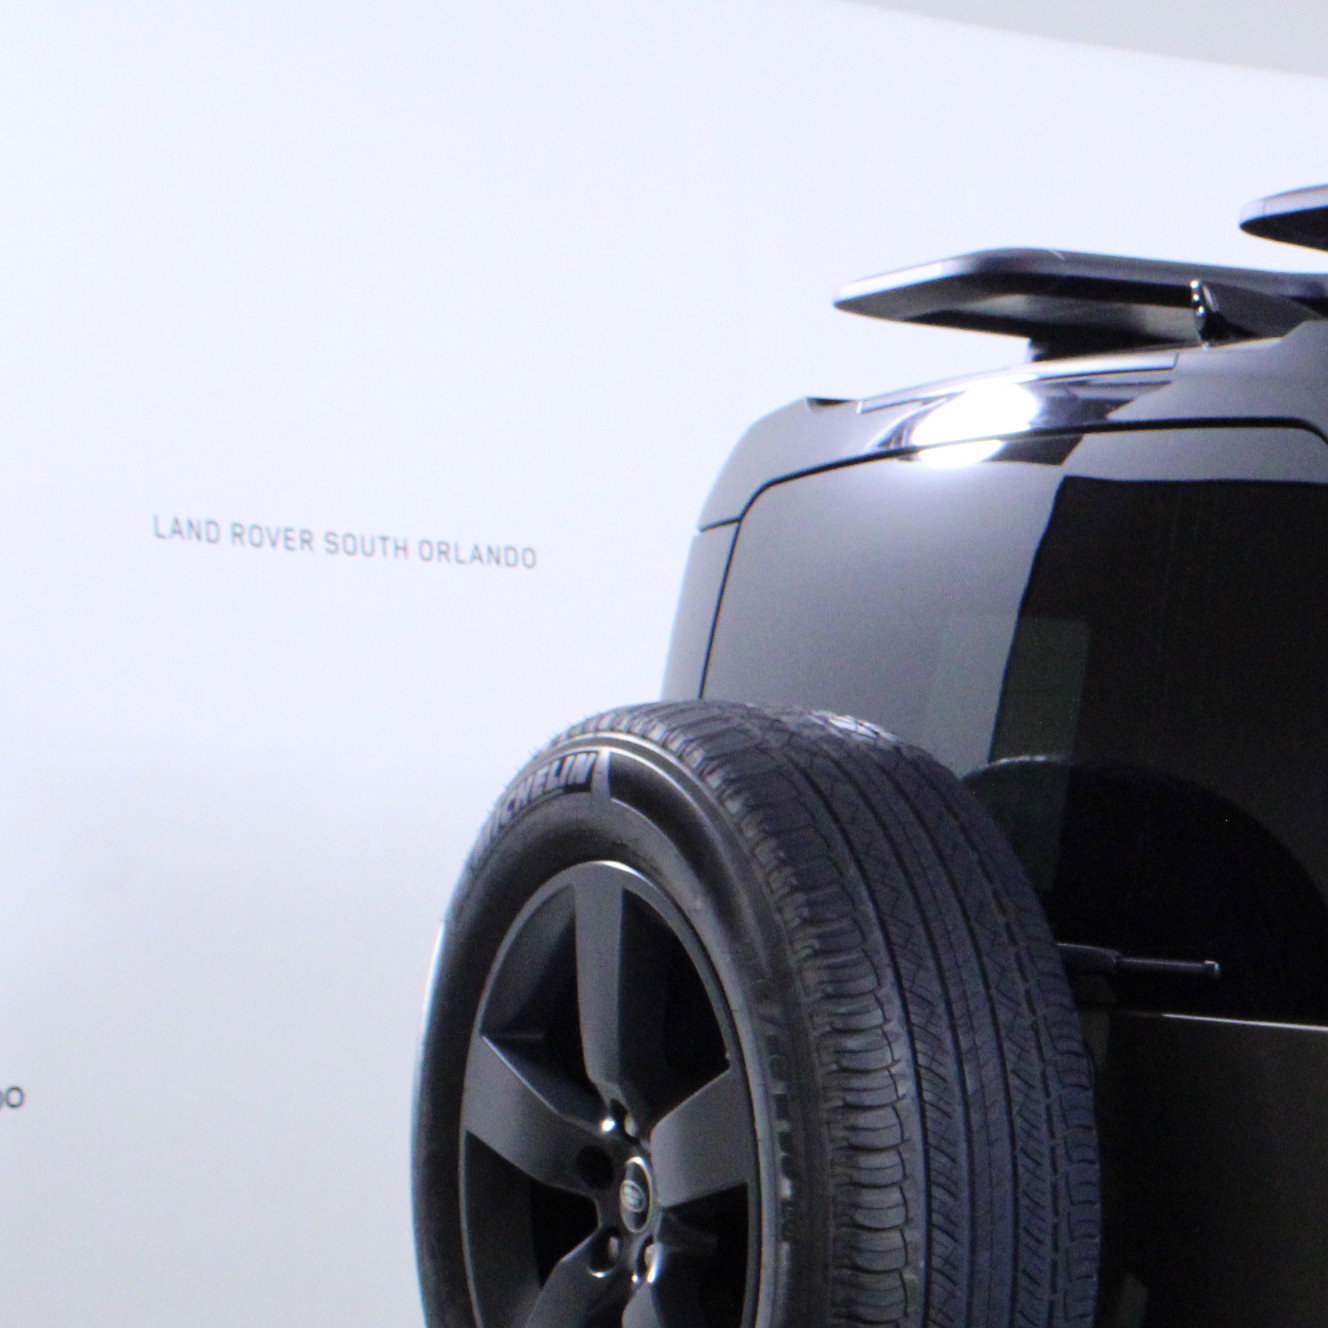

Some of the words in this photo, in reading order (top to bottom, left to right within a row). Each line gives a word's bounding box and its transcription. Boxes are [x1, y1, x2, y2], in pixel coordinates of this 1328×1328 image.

[152, 515, 220, 545] LAND
[231, 523, 315, 553] ROVER
[324, 531, 409, 560] SOUTH
[418, 539, 538, 570] ORLANDO
